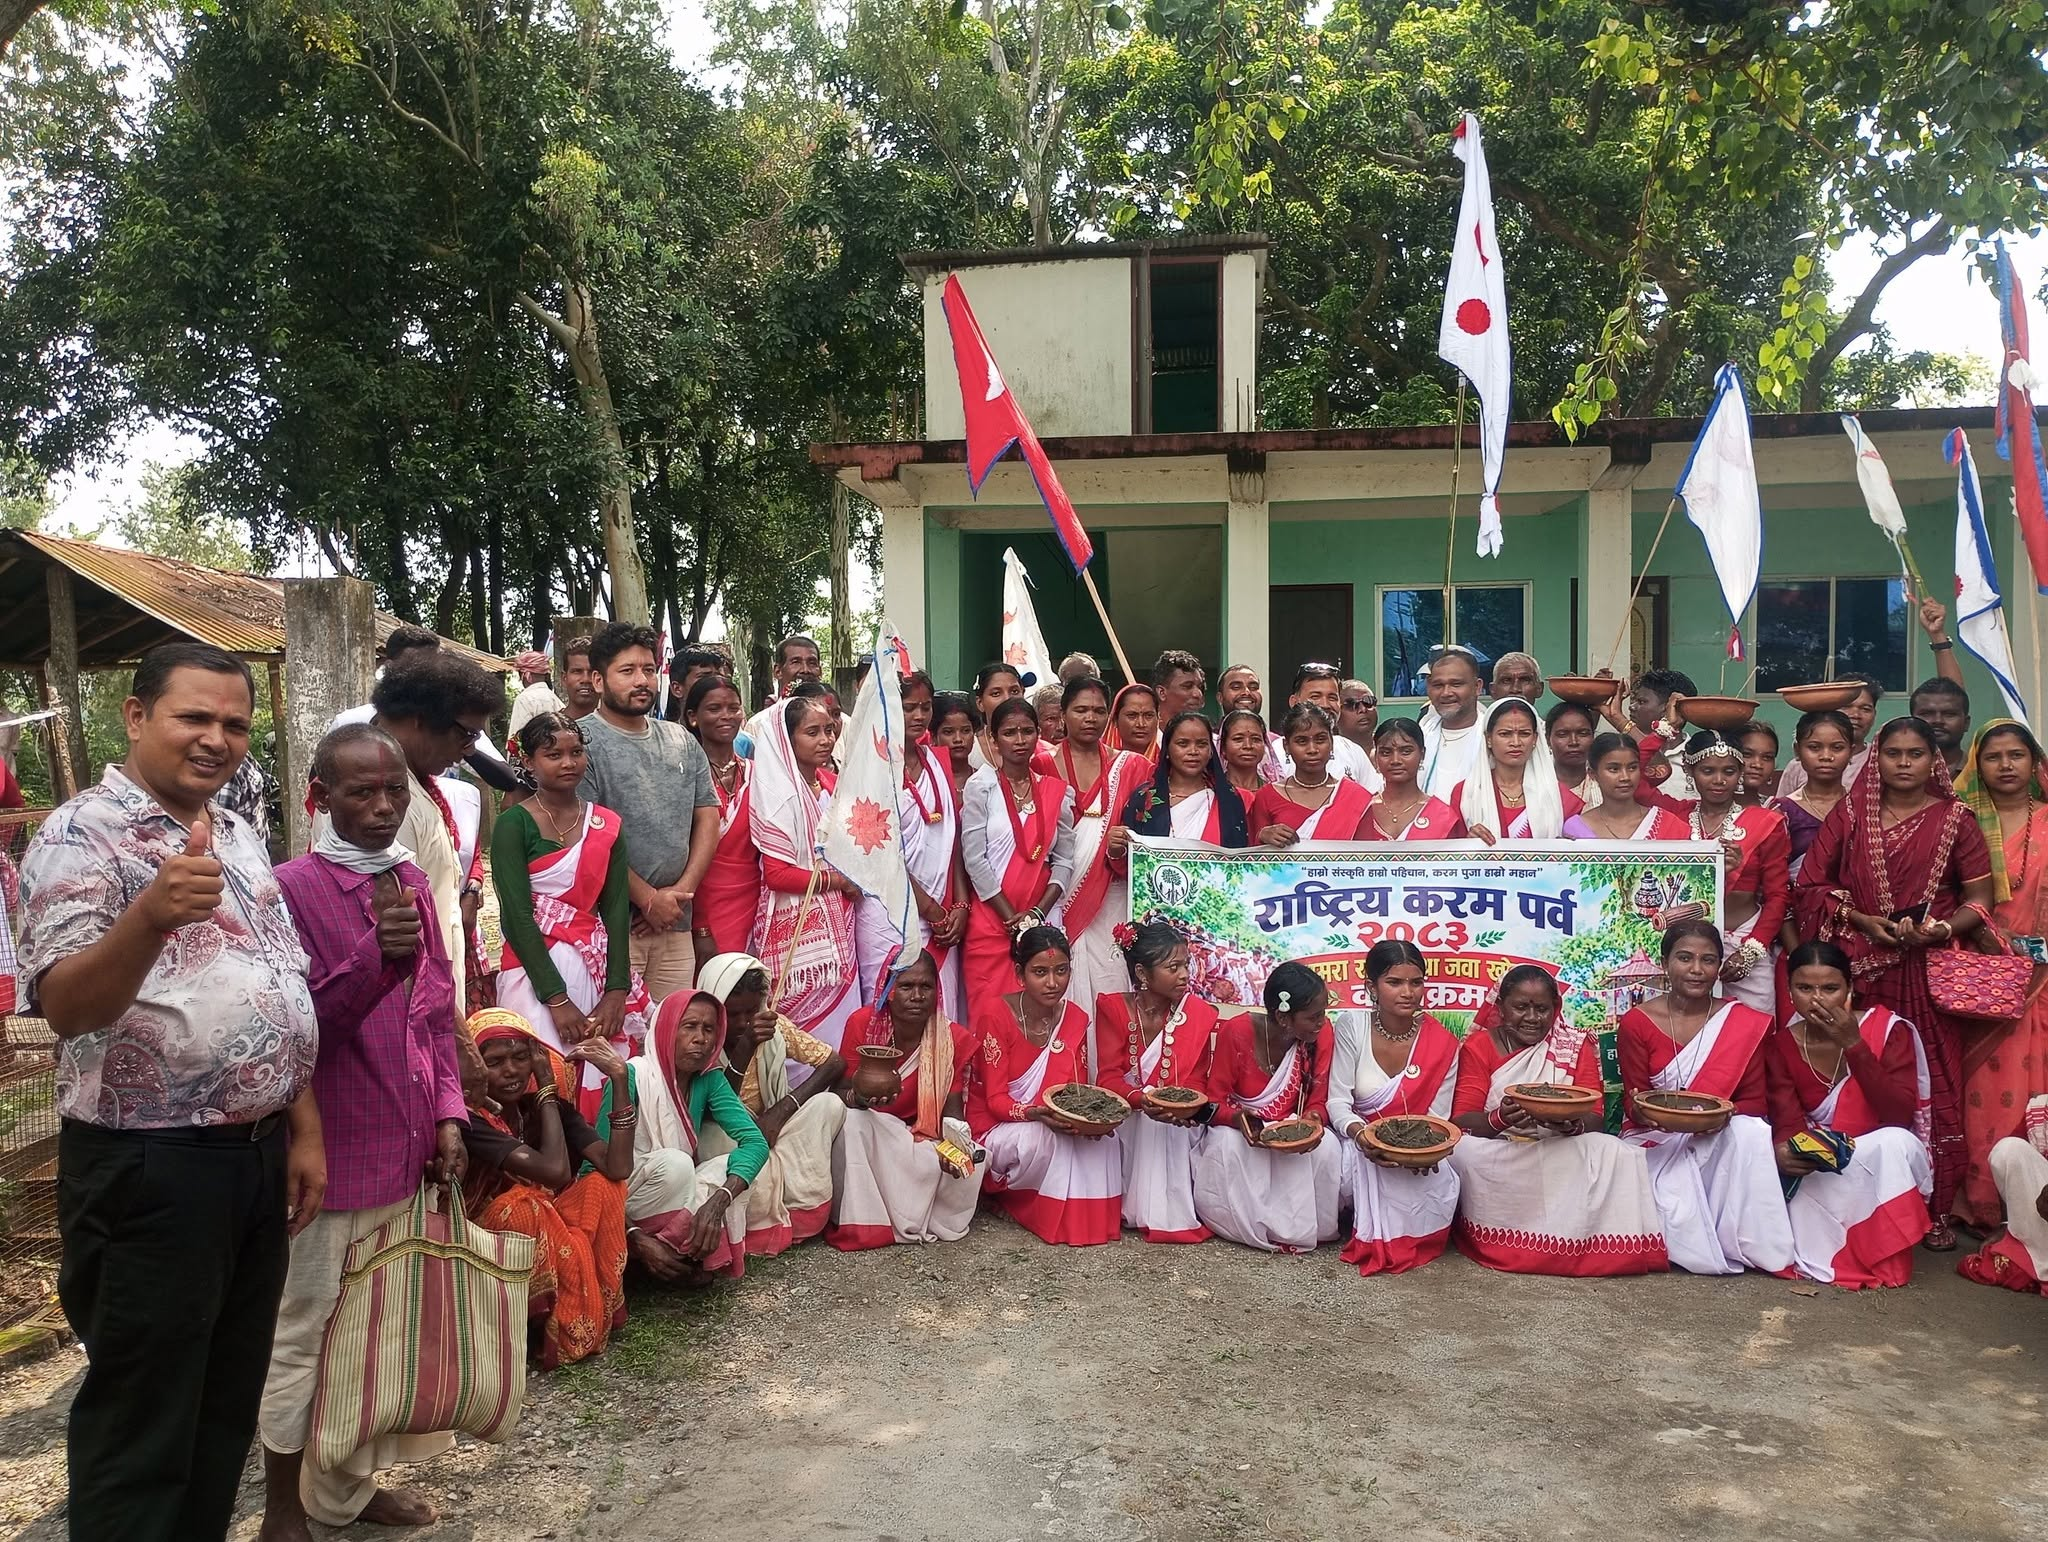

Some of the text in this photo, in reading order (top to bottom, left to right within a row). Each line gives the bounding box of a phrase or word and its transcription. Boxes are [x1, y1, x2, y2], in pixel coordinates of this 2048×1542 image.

[1331, 866, 1365, 880] संस्कृति
[1368, 866, 1388, 878] हाम्रो
[1391, 867, 1429, 879] पहिचान,
[1432, 868, 1458, 877] करम
[1484, 866, 1505, 878] हाम्रो
[1253, 880, 1577, 937] राष्ट्रिय करम पर्व
[1356, 921, 1469, 952] २०८३
[1444, 957, 1481, 979] जवा
